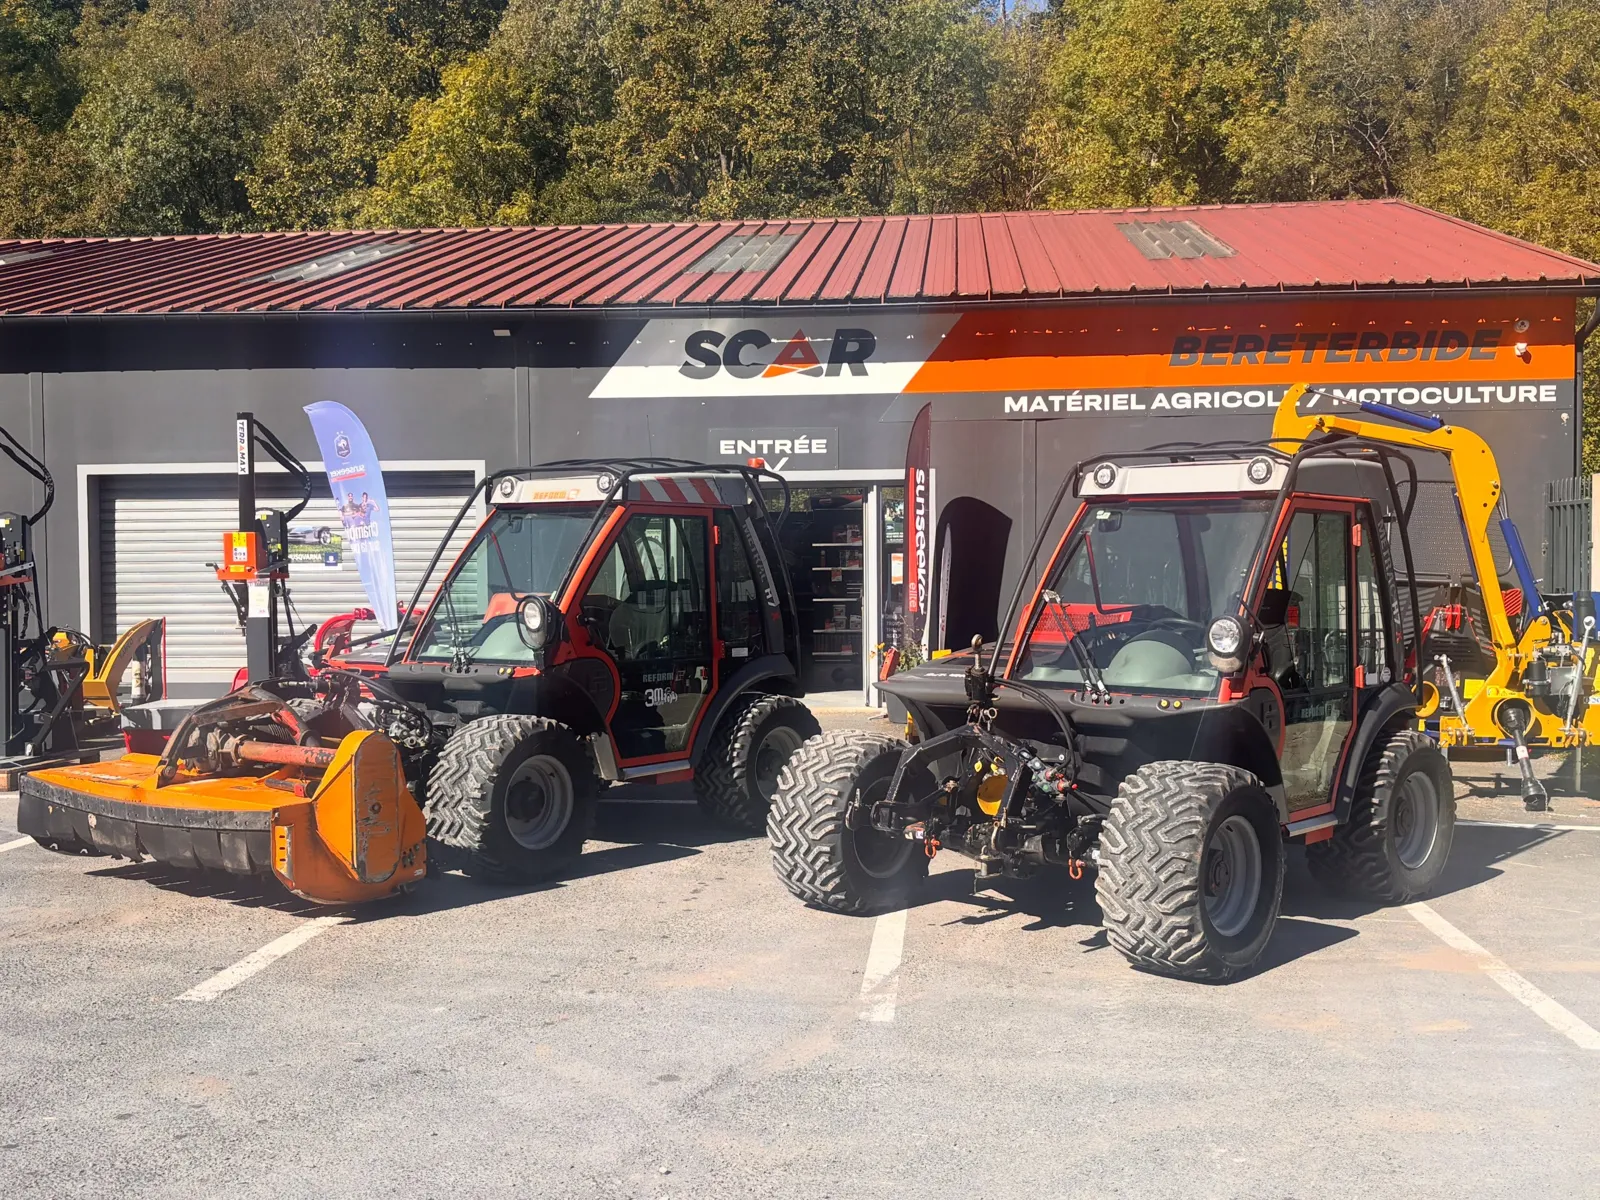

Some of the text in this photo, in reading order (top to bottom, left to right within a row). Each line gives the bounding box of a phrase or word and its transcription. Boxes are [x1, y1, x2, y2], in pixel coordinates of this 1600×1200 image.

[678, 328, 876, 380] SCAR
[1168, 329, 1502, 367] BERETERBIDE
[1004, 390, 1146, 413] MATÉRIEL
[1150, 390, 1300, 410] AGRICOL
[1332, 385, 1557, 406] MOTOCULTURE
[719, 434, 827, 455] ENTRÉE
[642, 672, 674, 683] REFORM
